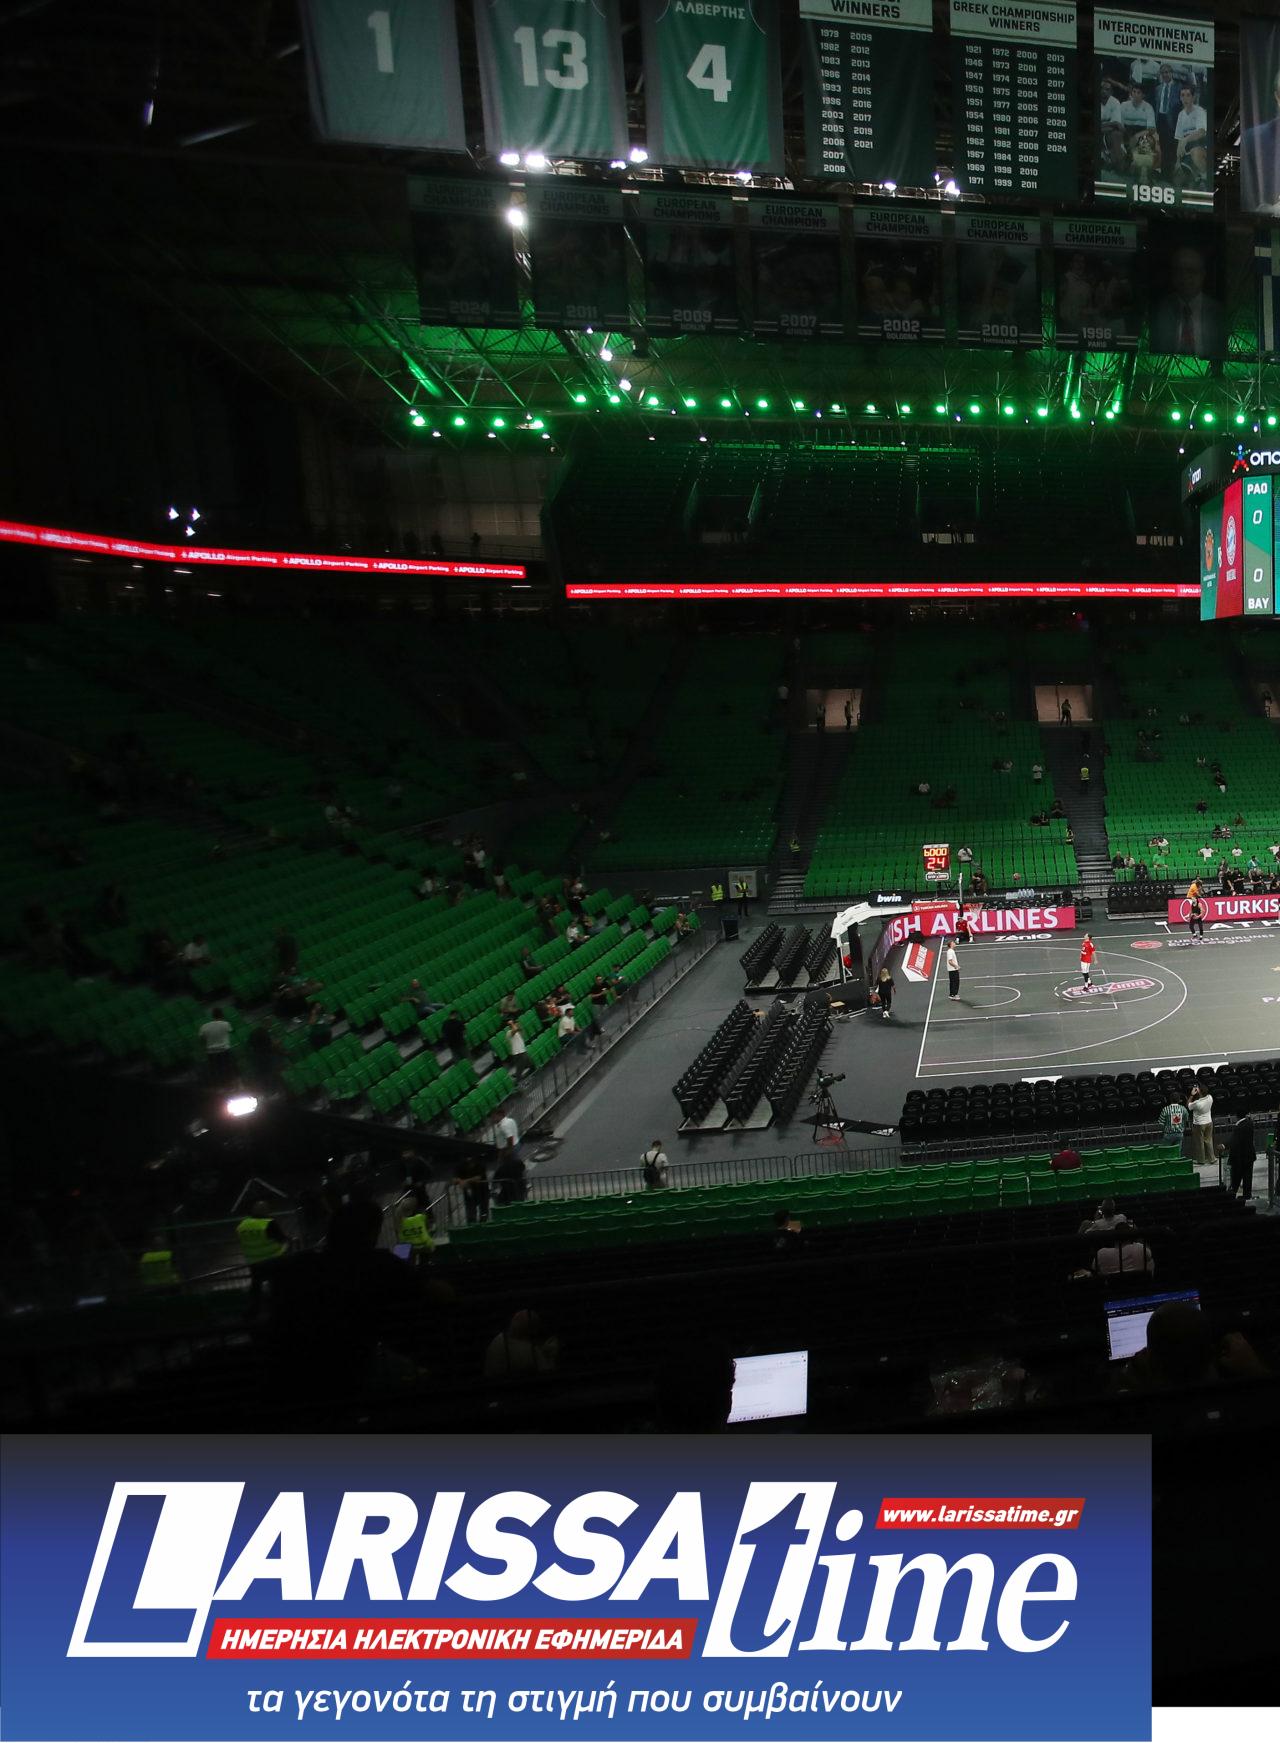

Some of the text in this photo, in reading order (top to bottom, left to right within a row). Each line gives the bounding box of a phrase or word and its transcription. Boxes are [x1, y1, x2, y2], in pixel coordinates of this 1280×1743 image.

[831, 0, 900, 18] WINNERS
[953, 1, 1074, 24] GREEK CHAMPIONSHIP
[989, 17, 1040, 32] WINNERS
[1098, 19, 1209, 43] INTERCONTINENTAL
[367, 10, 394, 74] 1
[1113, 34, 1194, 54] CUP WINNERS
[513, 26, 589, 90] 13
[686, 43, 732, 103] 4
[1132, 184, 1175, 205] 1996
[1247, 483, 1267, 495] PAO
[1252, 509, 1263, 525] 0
[1253, 568, 1263, 583] 0
[1248, 598, 1270, 609] BAY
[927, 857, 946, 869] 24
[877, 893, 902, 903] bwin
[1215, 898, 1280, 916] TURKIS
[931, 907, 1058, 936] AIRLINES
